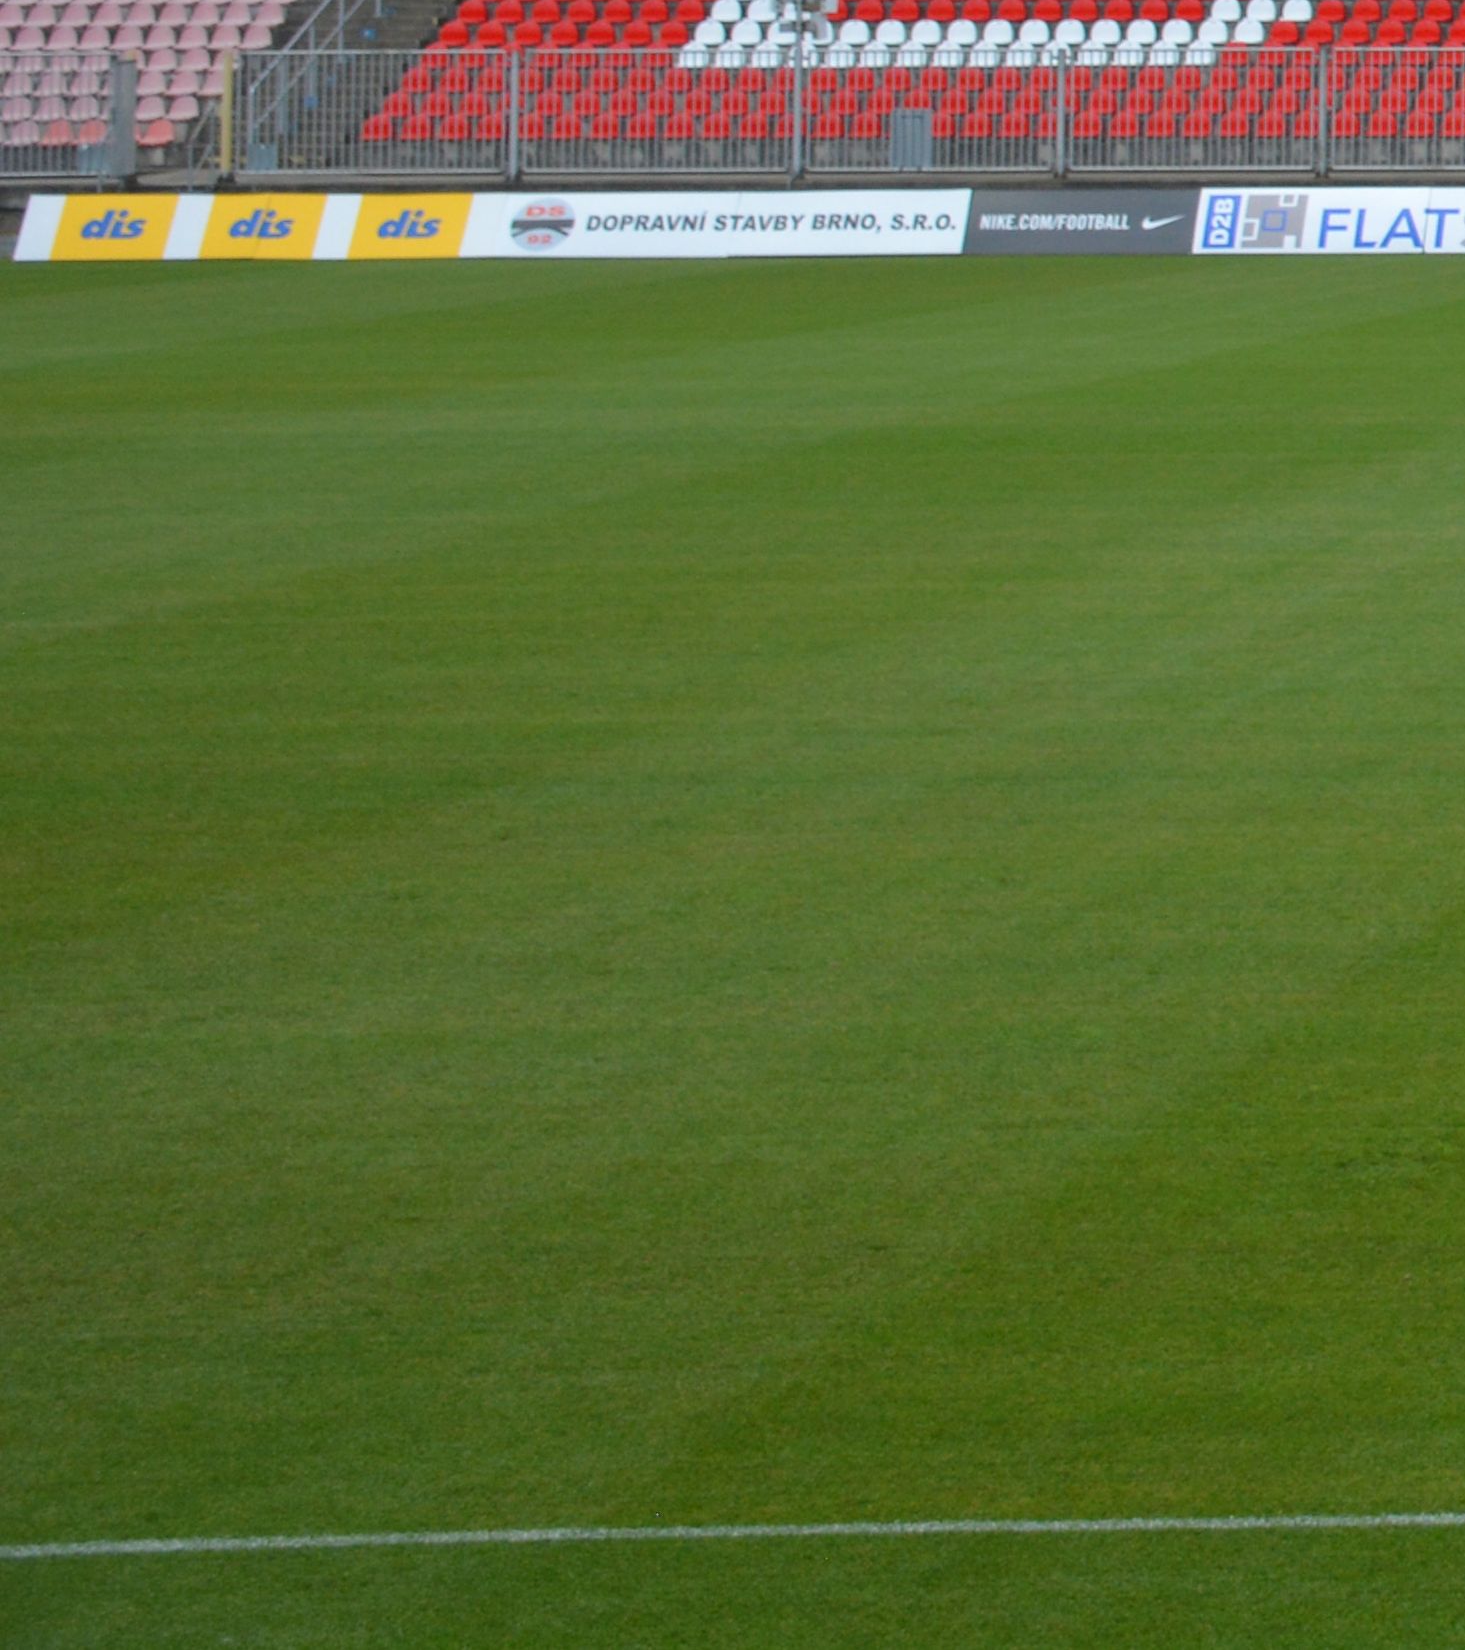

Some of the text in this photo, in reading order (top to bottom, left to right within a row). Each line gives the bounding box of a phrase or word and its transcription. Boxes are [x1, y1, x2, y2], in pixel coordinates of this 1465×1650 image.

[81, 210, 146, 239] dis
[229, 210, 293, 239] dis
[377, 210, 441, 239] dis
[586, 210, 957, 234] DOPRAVNÍ STAVBY BRNO, S.R.O.
[979, 213, 1131, 232] NIKE.COM/FOOTBALL
